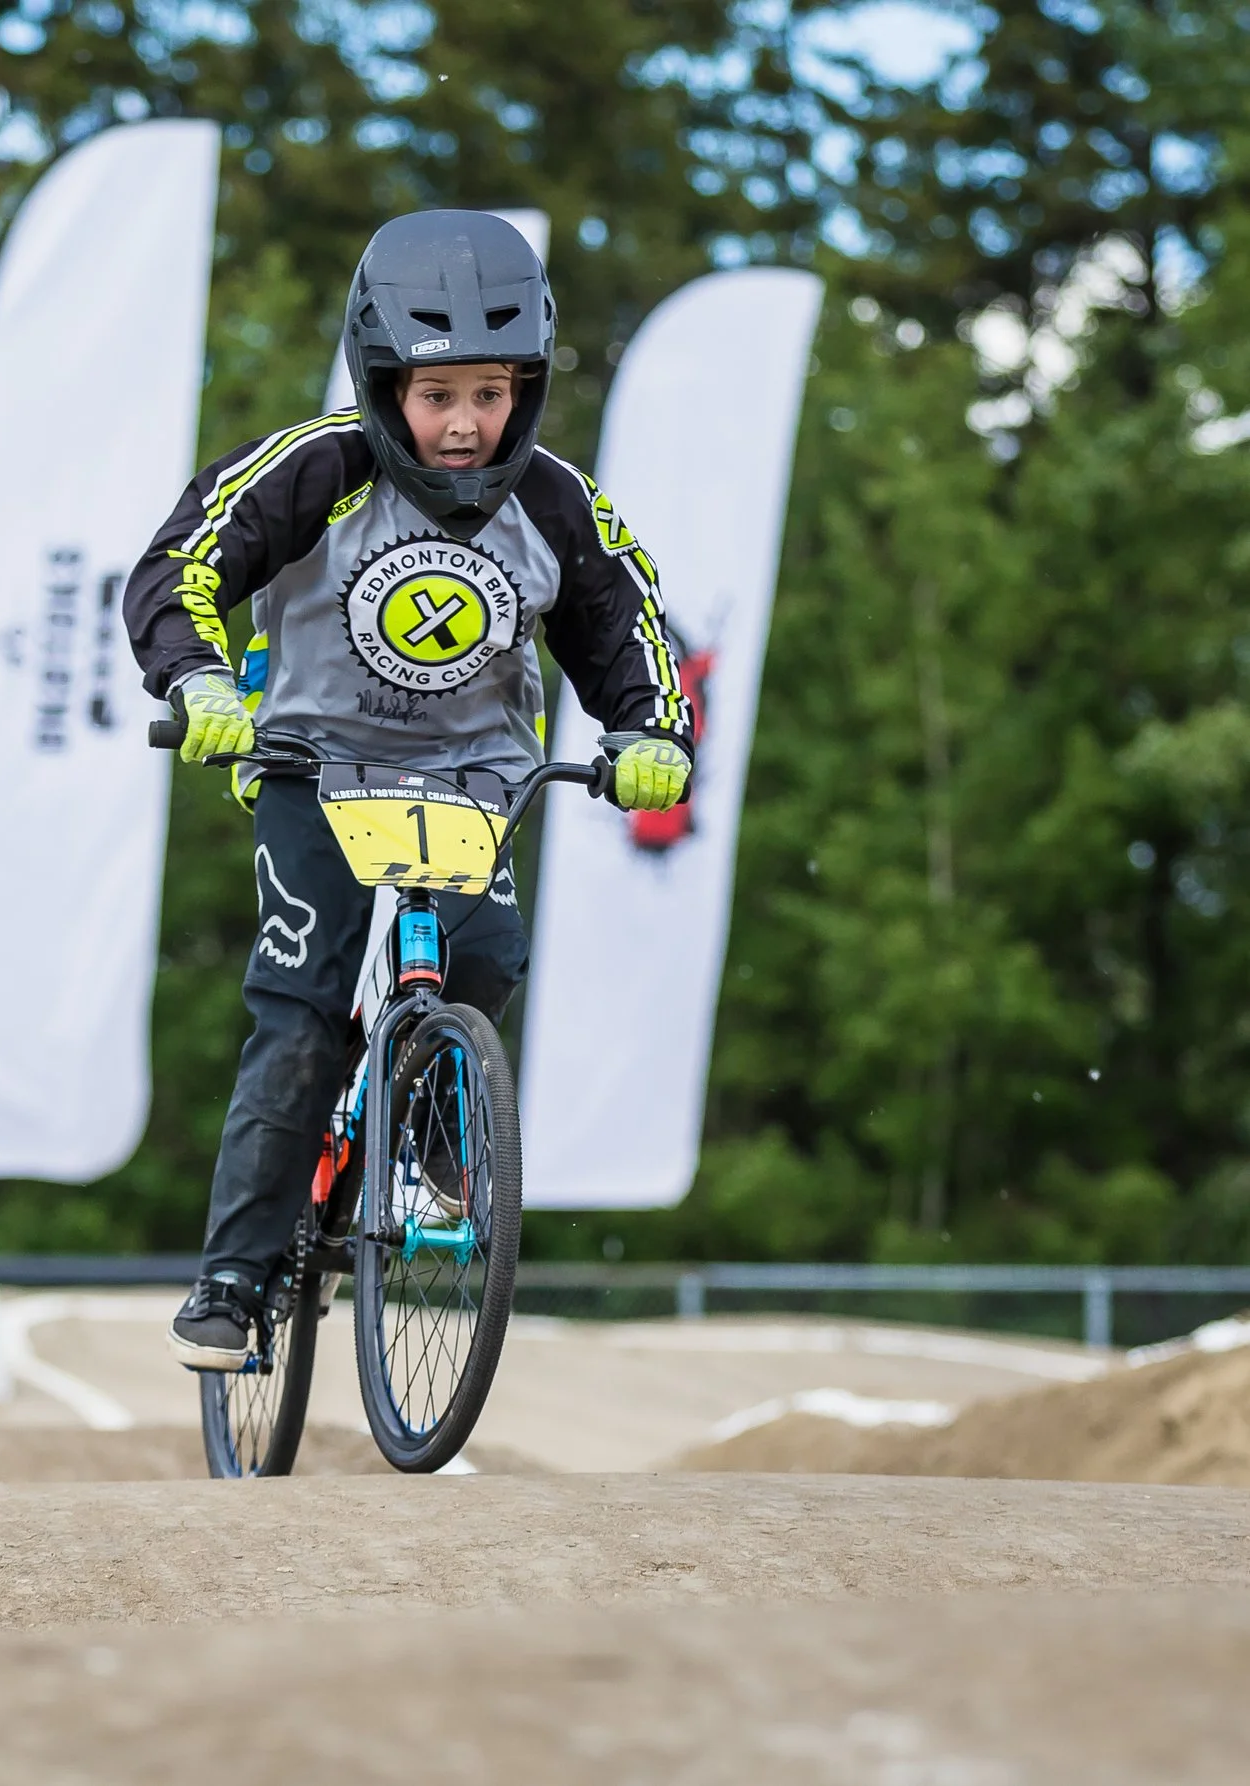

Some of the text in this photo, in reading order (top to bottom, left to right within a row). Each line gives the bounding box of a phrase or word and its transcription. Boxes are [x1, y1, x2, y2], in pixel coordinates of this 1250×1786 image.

[360, 549, 510, 623] EDMONTON BMX
[358, 631, 494, 685] RACING CLUB
[330, 788, 500, 813] ALBERTA PROVINCIAL CHAMPIONHIPS
[407, 804, 429, 864] 1
